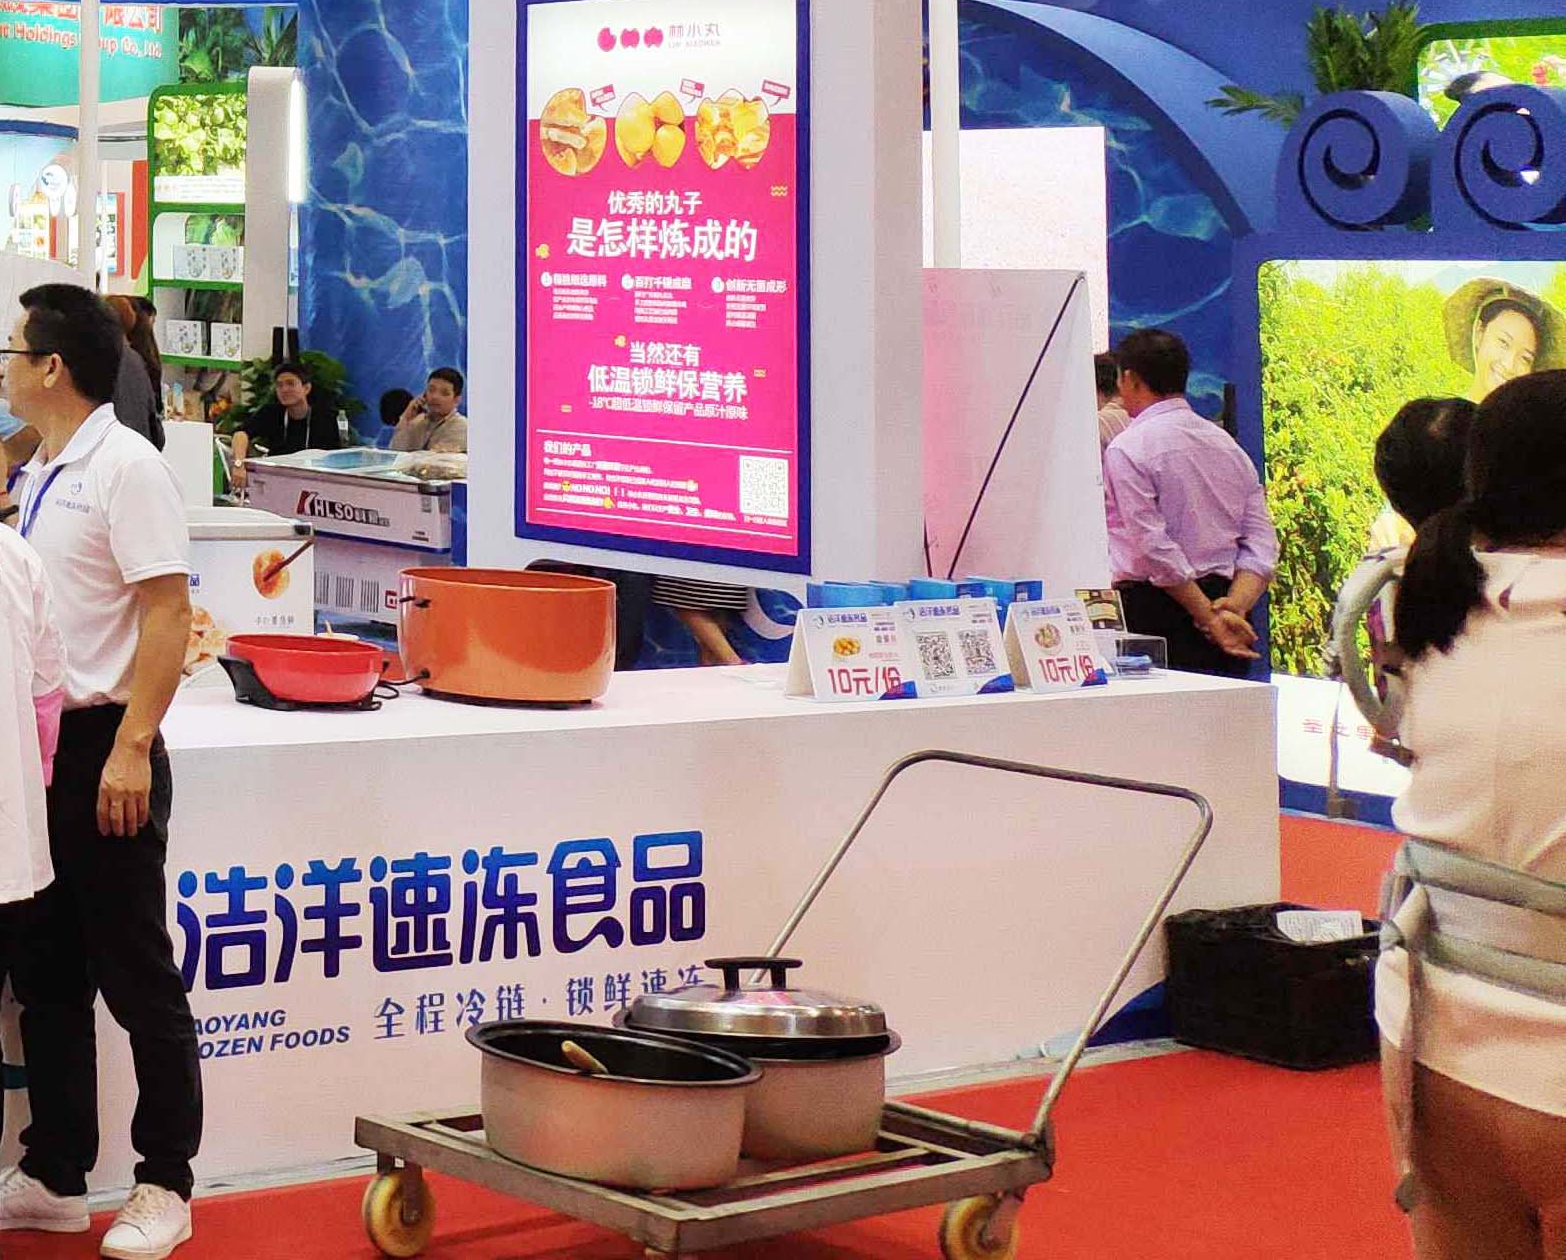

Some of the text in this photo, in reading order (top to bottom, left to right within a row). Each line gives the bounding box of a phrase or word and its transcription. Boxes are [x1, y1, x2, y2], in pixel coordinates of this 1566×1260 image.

[607, 190, 703, 215] 优秀的丸子
[566, 216, 758, 262] 是怎样炼成的
[629, 340, 702, 368] 当然还有
[587, 363, 748, 403] 低温锁鲜保营养
[827, 666, 902, 696] 10元/份
[1038, 654, 1096, 684] 10元/份
[176, 829, 706, 994] 浩洋速冻食品
[190, 1008, 287, 1037] AOYANG
[197, 1025, 351, 1061] OZEN FOODS
